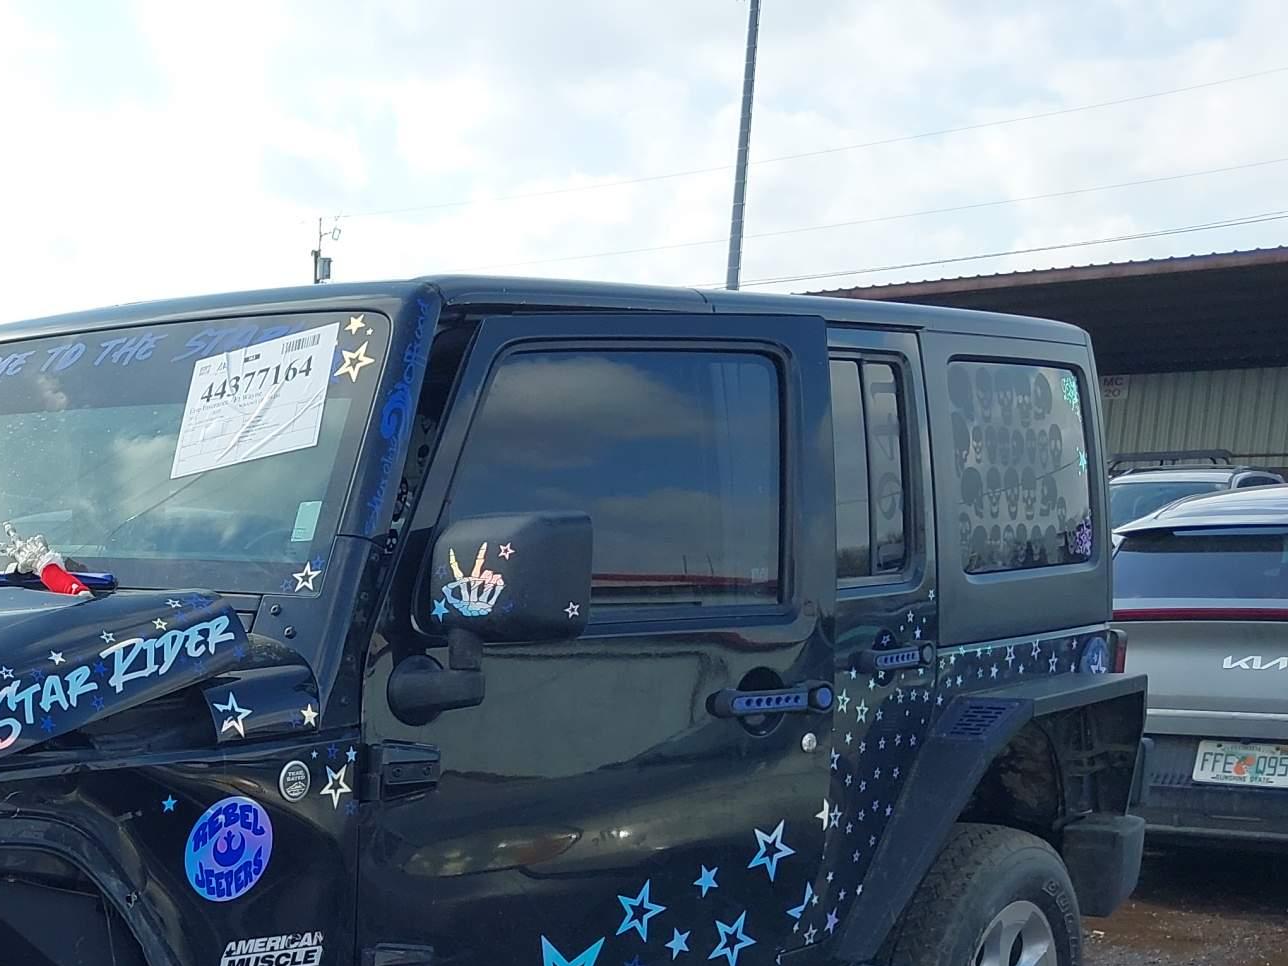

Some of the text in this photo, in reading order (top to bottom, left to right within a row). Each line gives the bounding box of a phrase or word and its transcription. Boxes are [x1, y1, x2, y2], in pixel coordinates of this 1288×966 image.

[40, 342, 86, 372] TO
[94, 331, 168, 366] THE
[200, 355, 313, 402] 44377164
[99, 615, 236, 692] RIDER
[1222, 655, 1288, 670] KIA
[1200, 752, 1236, 774] FFE
[192, 802, 266, 852] REBEL
[194, 846, 264, 899] JEEPERS
[225, 931, 324, 957] AMERICAN
